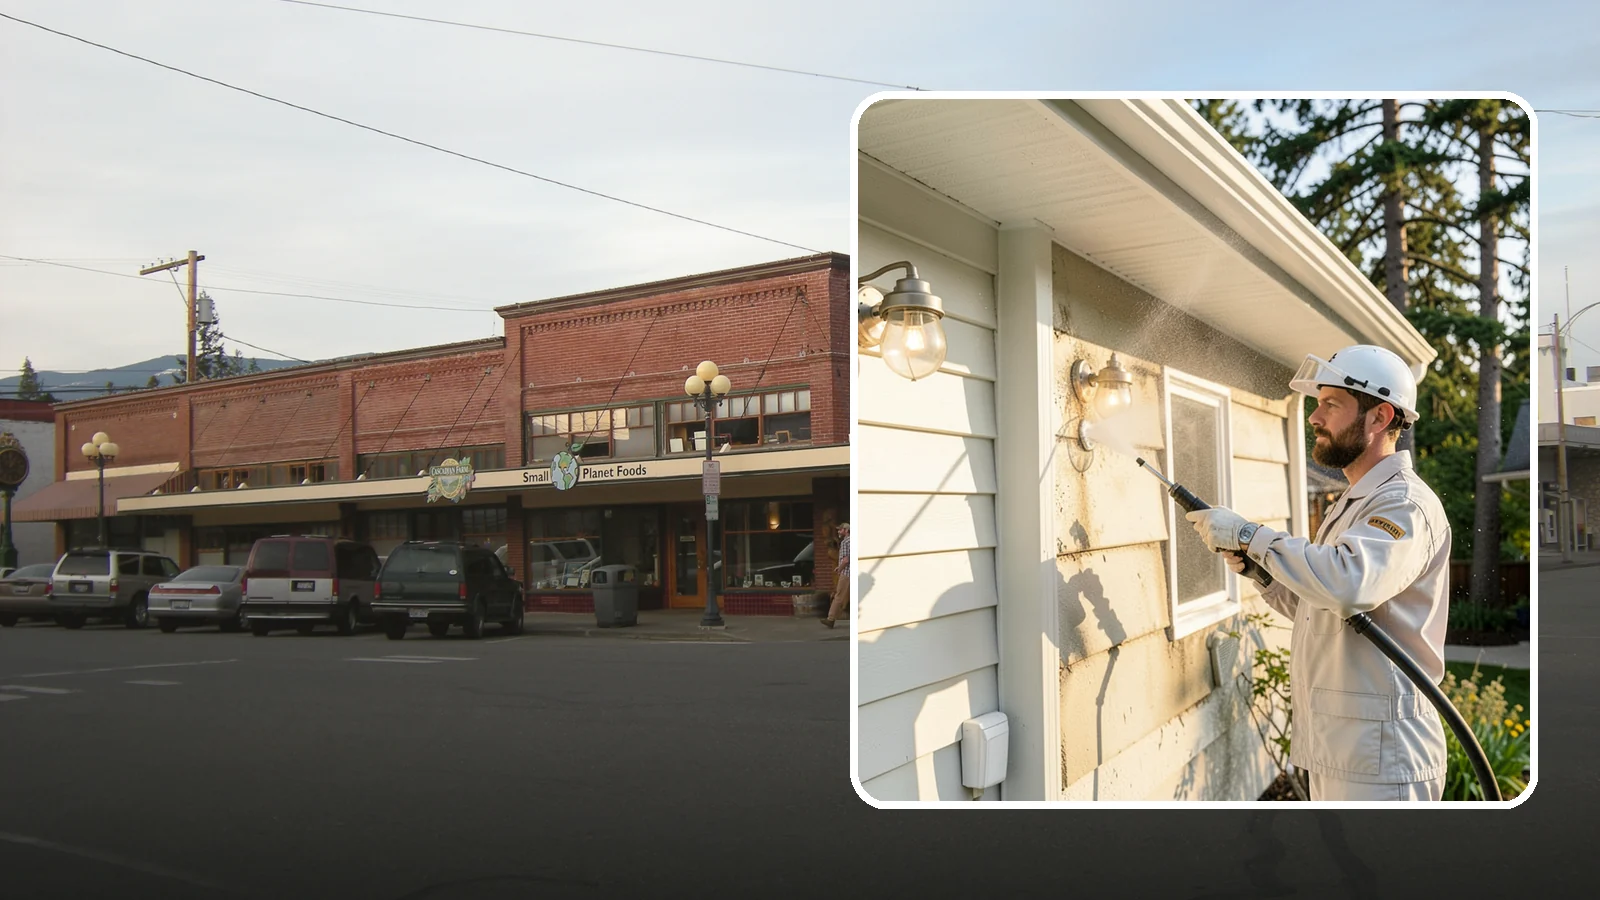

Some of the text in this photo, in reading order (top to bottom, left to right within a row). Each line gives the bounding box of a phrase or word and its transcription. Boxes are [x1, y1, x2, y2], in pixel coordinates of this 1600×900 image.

[523, 464, 647, 483] Small Planet Foods
